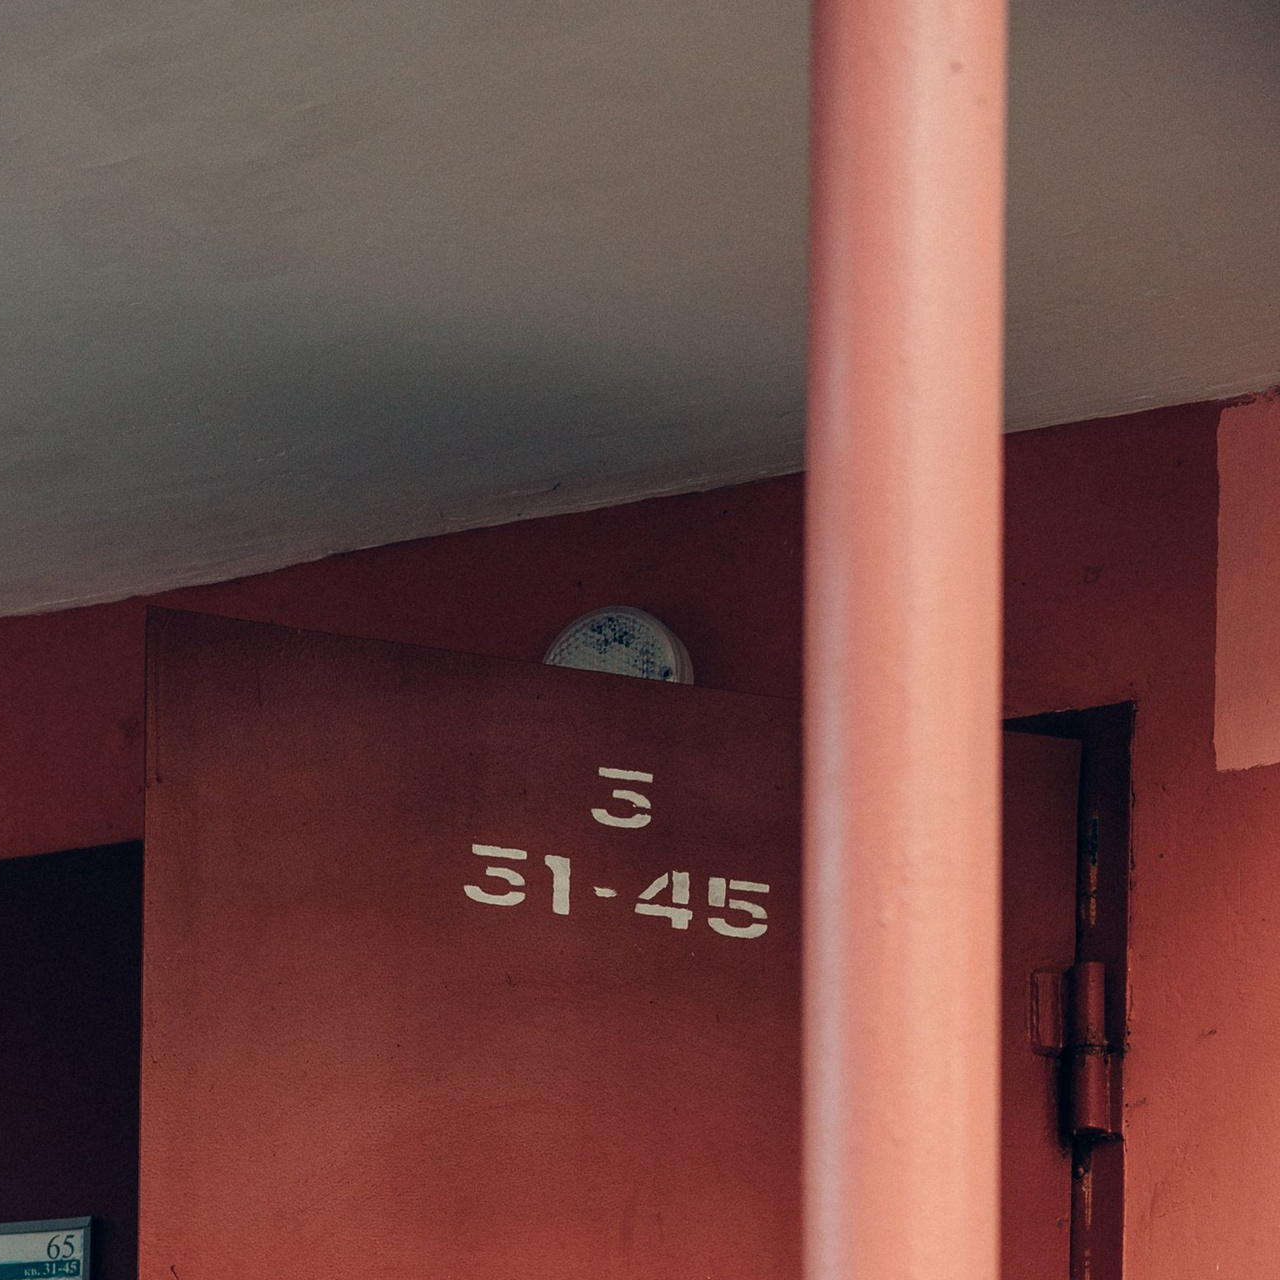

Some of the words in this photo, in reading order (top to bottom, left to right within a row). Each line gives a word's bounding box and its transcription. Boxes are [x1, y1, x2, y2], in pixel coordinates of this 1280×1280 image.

[591, 767, 653, 828] 3
[463, 843, 770, 939] 31-45
[43, 1261, 78, 1276] 31-45
[46, 1234, 75, 1260] 65
